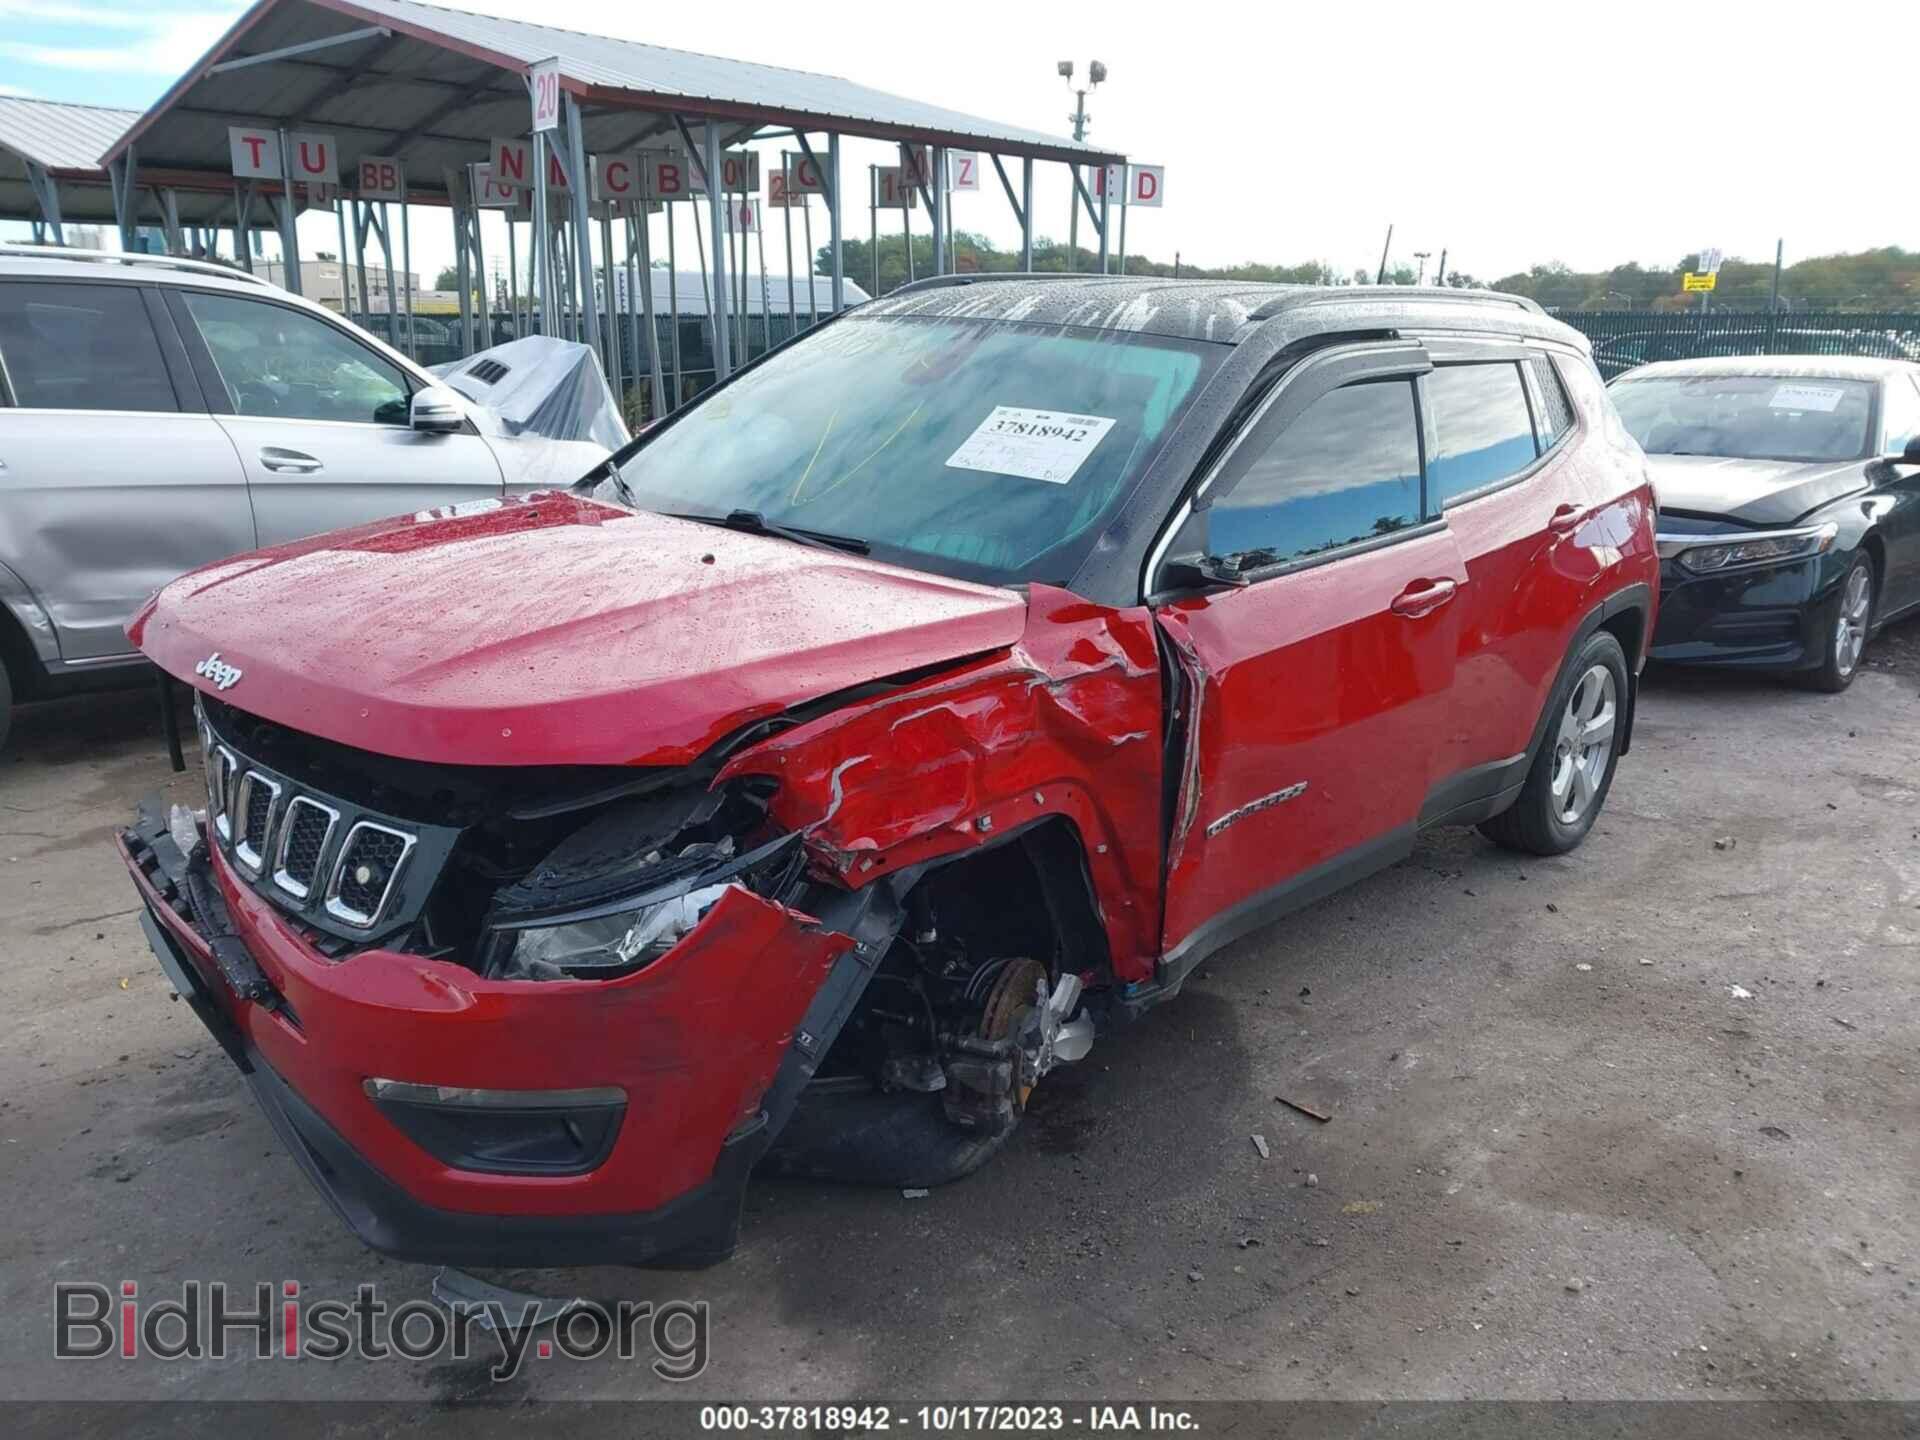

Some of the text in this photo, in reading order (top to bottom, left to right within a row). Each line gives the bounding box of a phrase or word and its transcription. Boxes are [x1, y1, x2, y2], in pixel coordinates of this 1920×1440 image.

[537, 71, 556, 119] 20
[242, 137, 267, 168] T
[300, 142, 326, 174] U
[500, 145, 522, 180] N
[362, 163, 397, 192] BB
[606, 162, 630, 192] C
[659, 164, 681, 193] B
[959, 158, 973, 185] Z
[1138, 171, 1157, 200] D
[990, 420, 1088, 442] 37818942
[195, 652, 243, 691] Jeep
